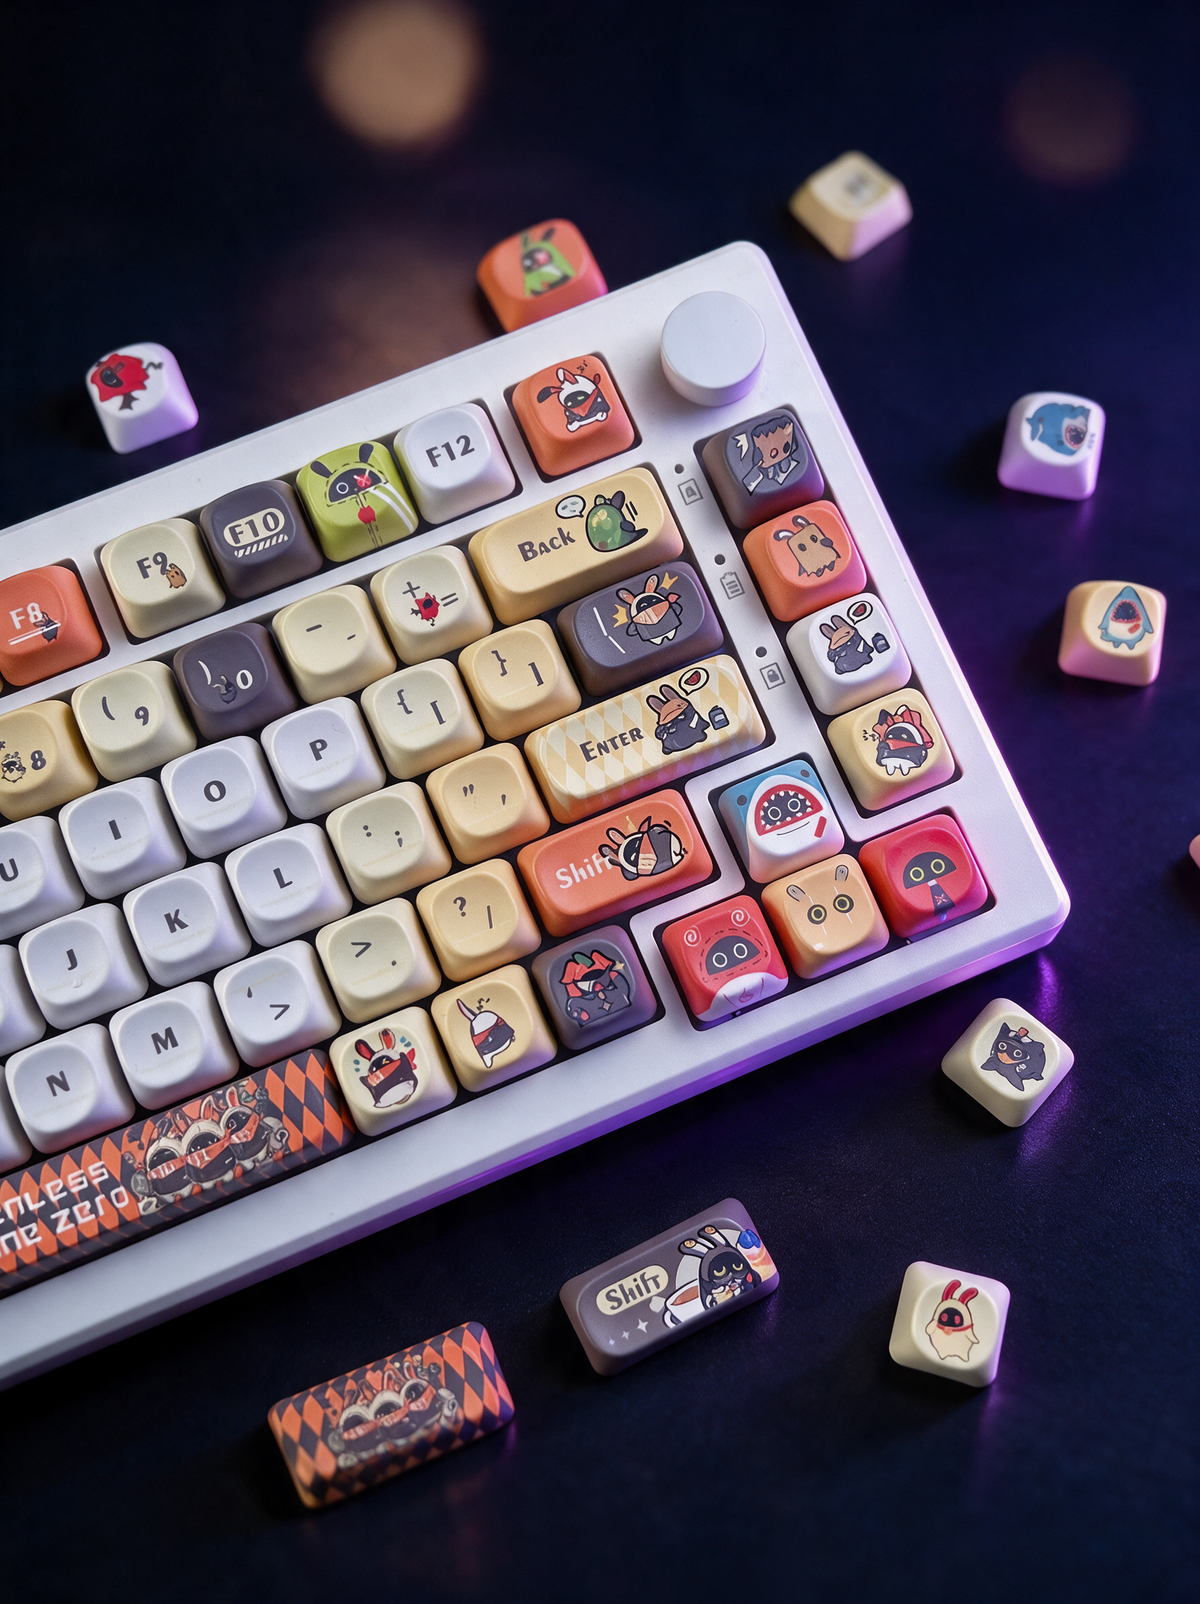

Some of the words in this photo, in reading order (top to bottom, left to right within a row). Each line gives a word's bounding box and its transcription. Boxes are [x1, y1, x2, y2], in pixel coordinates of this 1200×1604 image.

[425, 434, 475, 468] F12
[228, 511, 280, 545] F10
[136, 551, 169, 580] F9
[9, 602, 42, 630] F8
[134, 706, 150, 727] 9
[30, 749, 47, 771] 8
[308, 738, 328, 762] P
[203, 780, 227, 803] O
[108, 819, 122, 841] I
[0, 857, 19, 882] U
[272, 867, 294, 889] L
[163, 908, 189, 934] K
[66, 948, 78, 971] J
[150, 1026, 179, 1055] M
[45, 1070, 71, 1097] N
[605, 1271, 662, 1311] Shift
